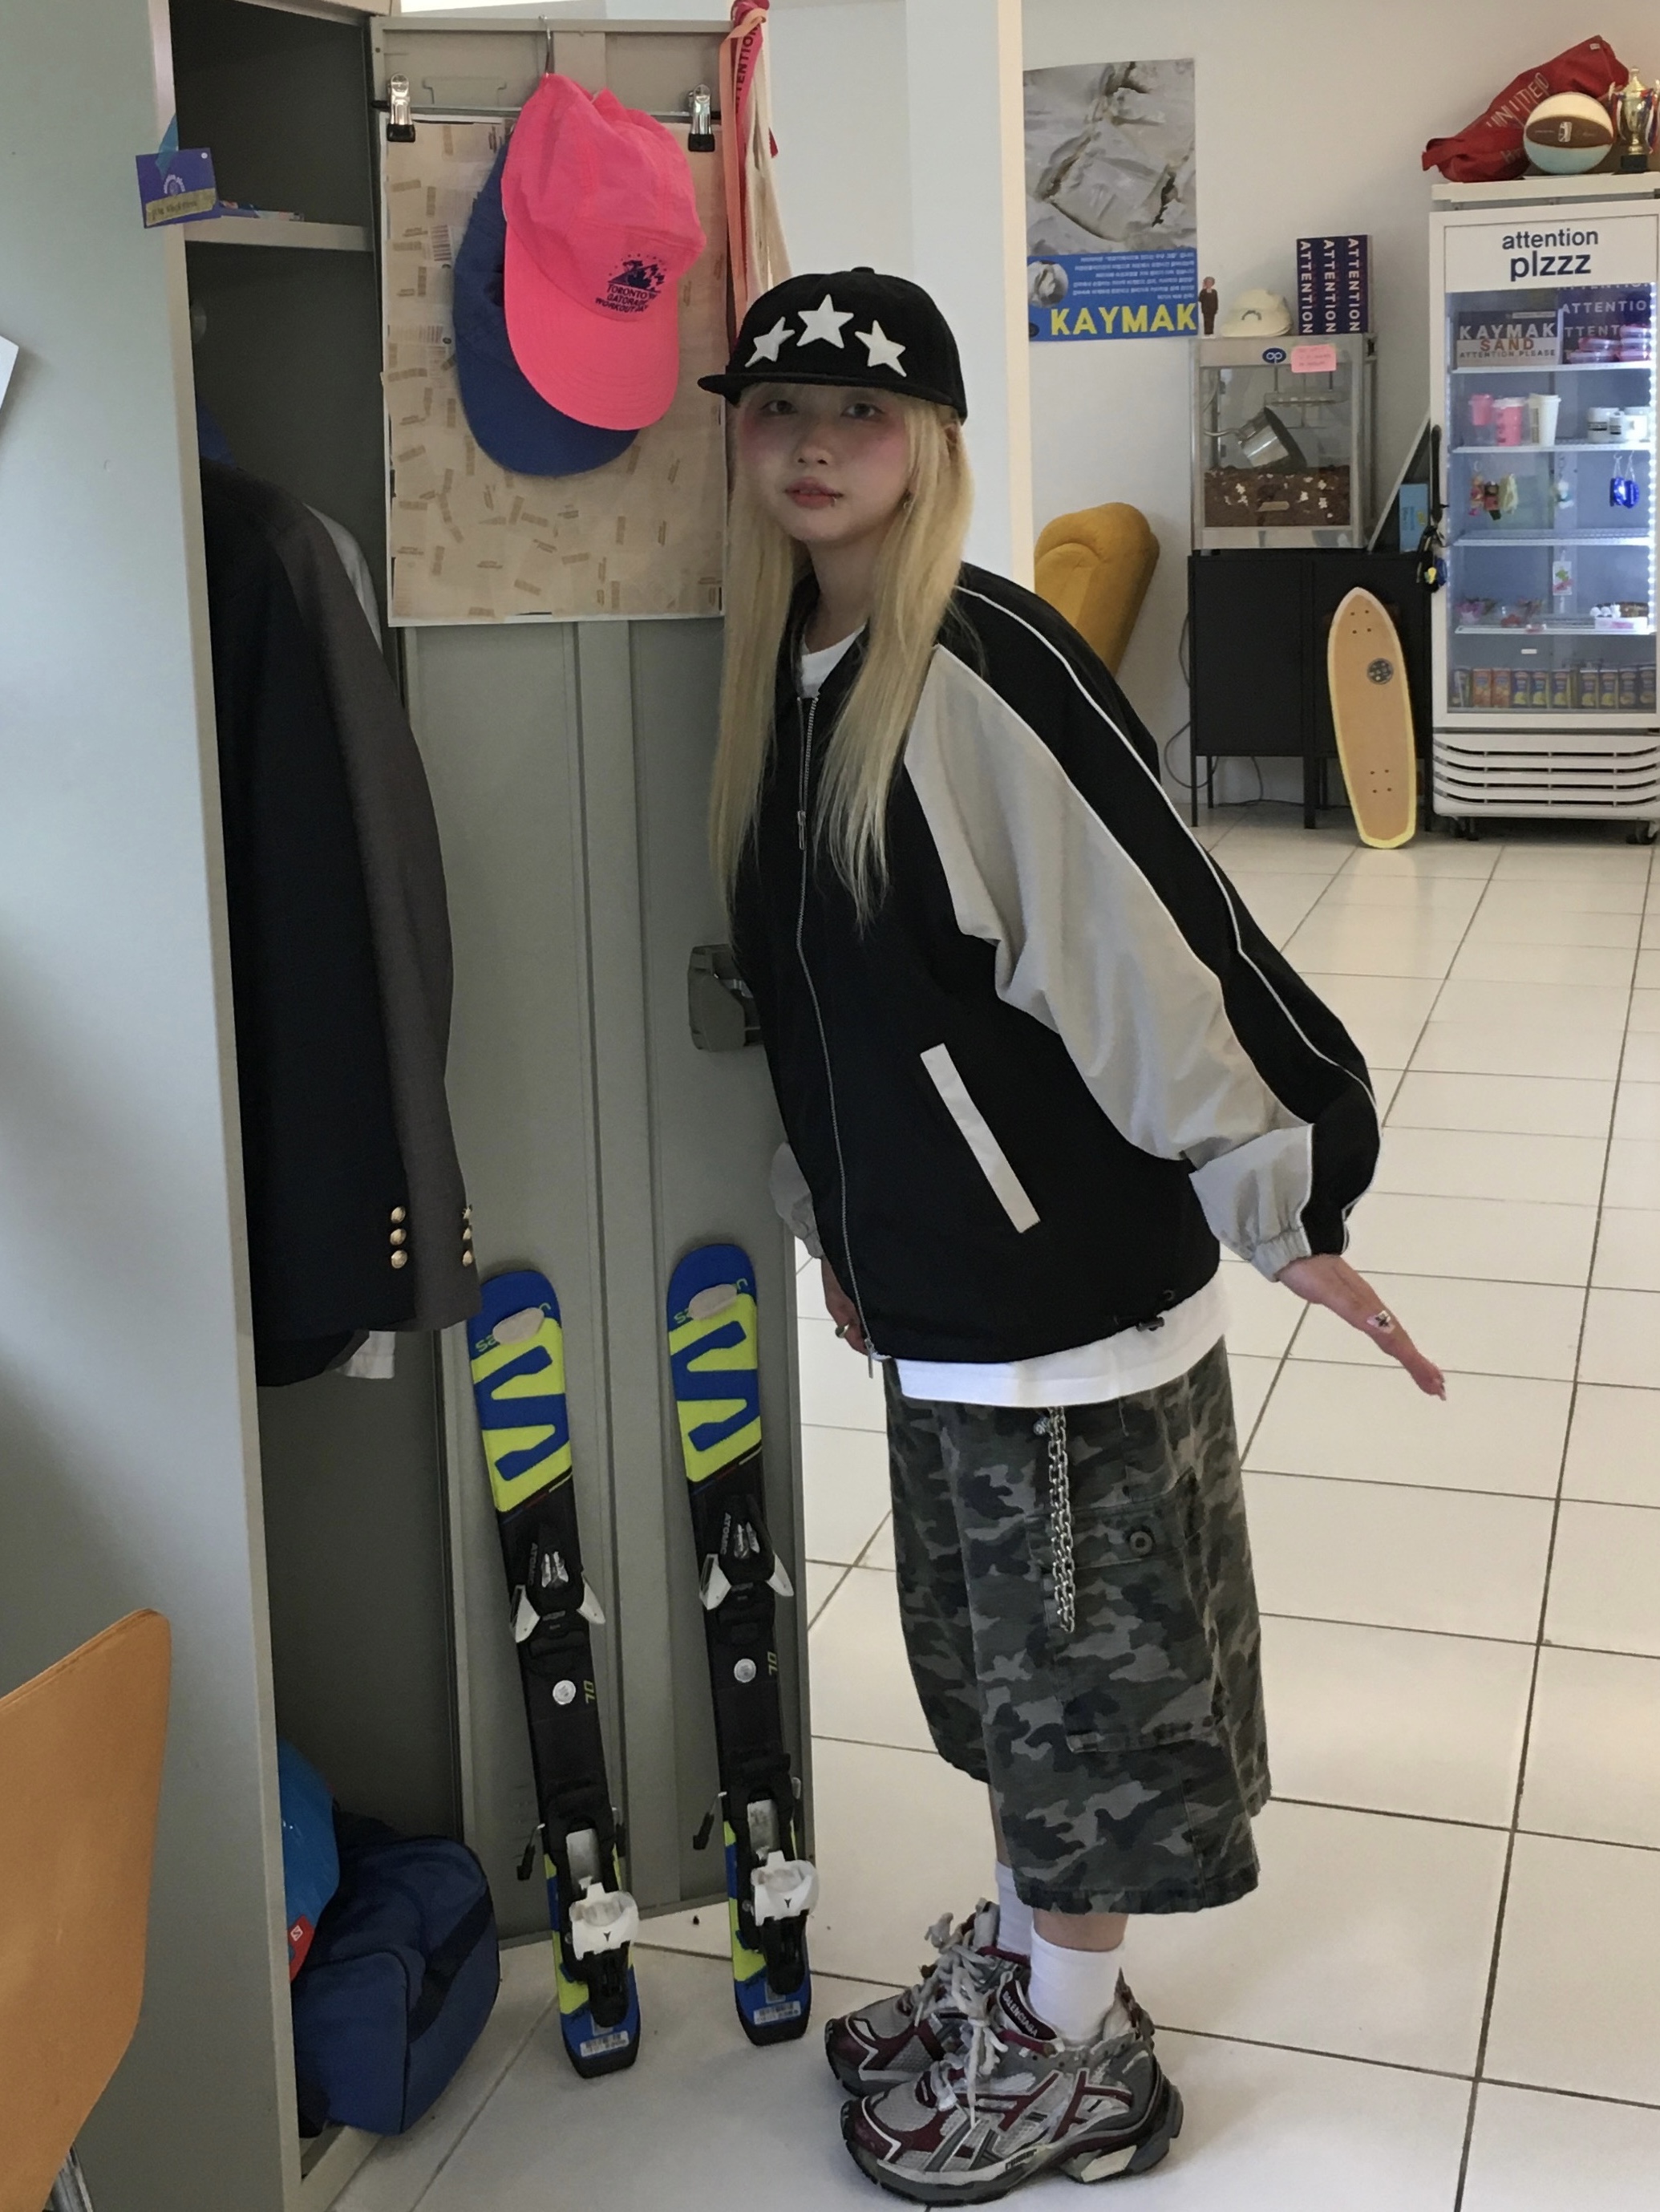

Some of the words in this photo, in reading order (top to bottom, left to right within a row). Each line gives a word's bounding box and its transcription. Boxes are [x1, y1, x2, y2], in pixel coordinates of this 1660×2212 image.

[1502, 228, 1599, 250] attention
[1510, 250, 1592, 282] plzzz
[607, 284, 647, 299] TORONTO
[1300, 241, 1314, 334] ATTENTION
[1323, 239, 1337, 333] ATTENTION
[1348, 238, 1361, 331] ATTENTION
[1051, 302, 1197, 336] KAYMAK
[1562, 299, 1647, 314] ATTENTIO
[1460, 322, 1555, 340] KAYMAK
[1480, 337, 1534, 352] SAND
